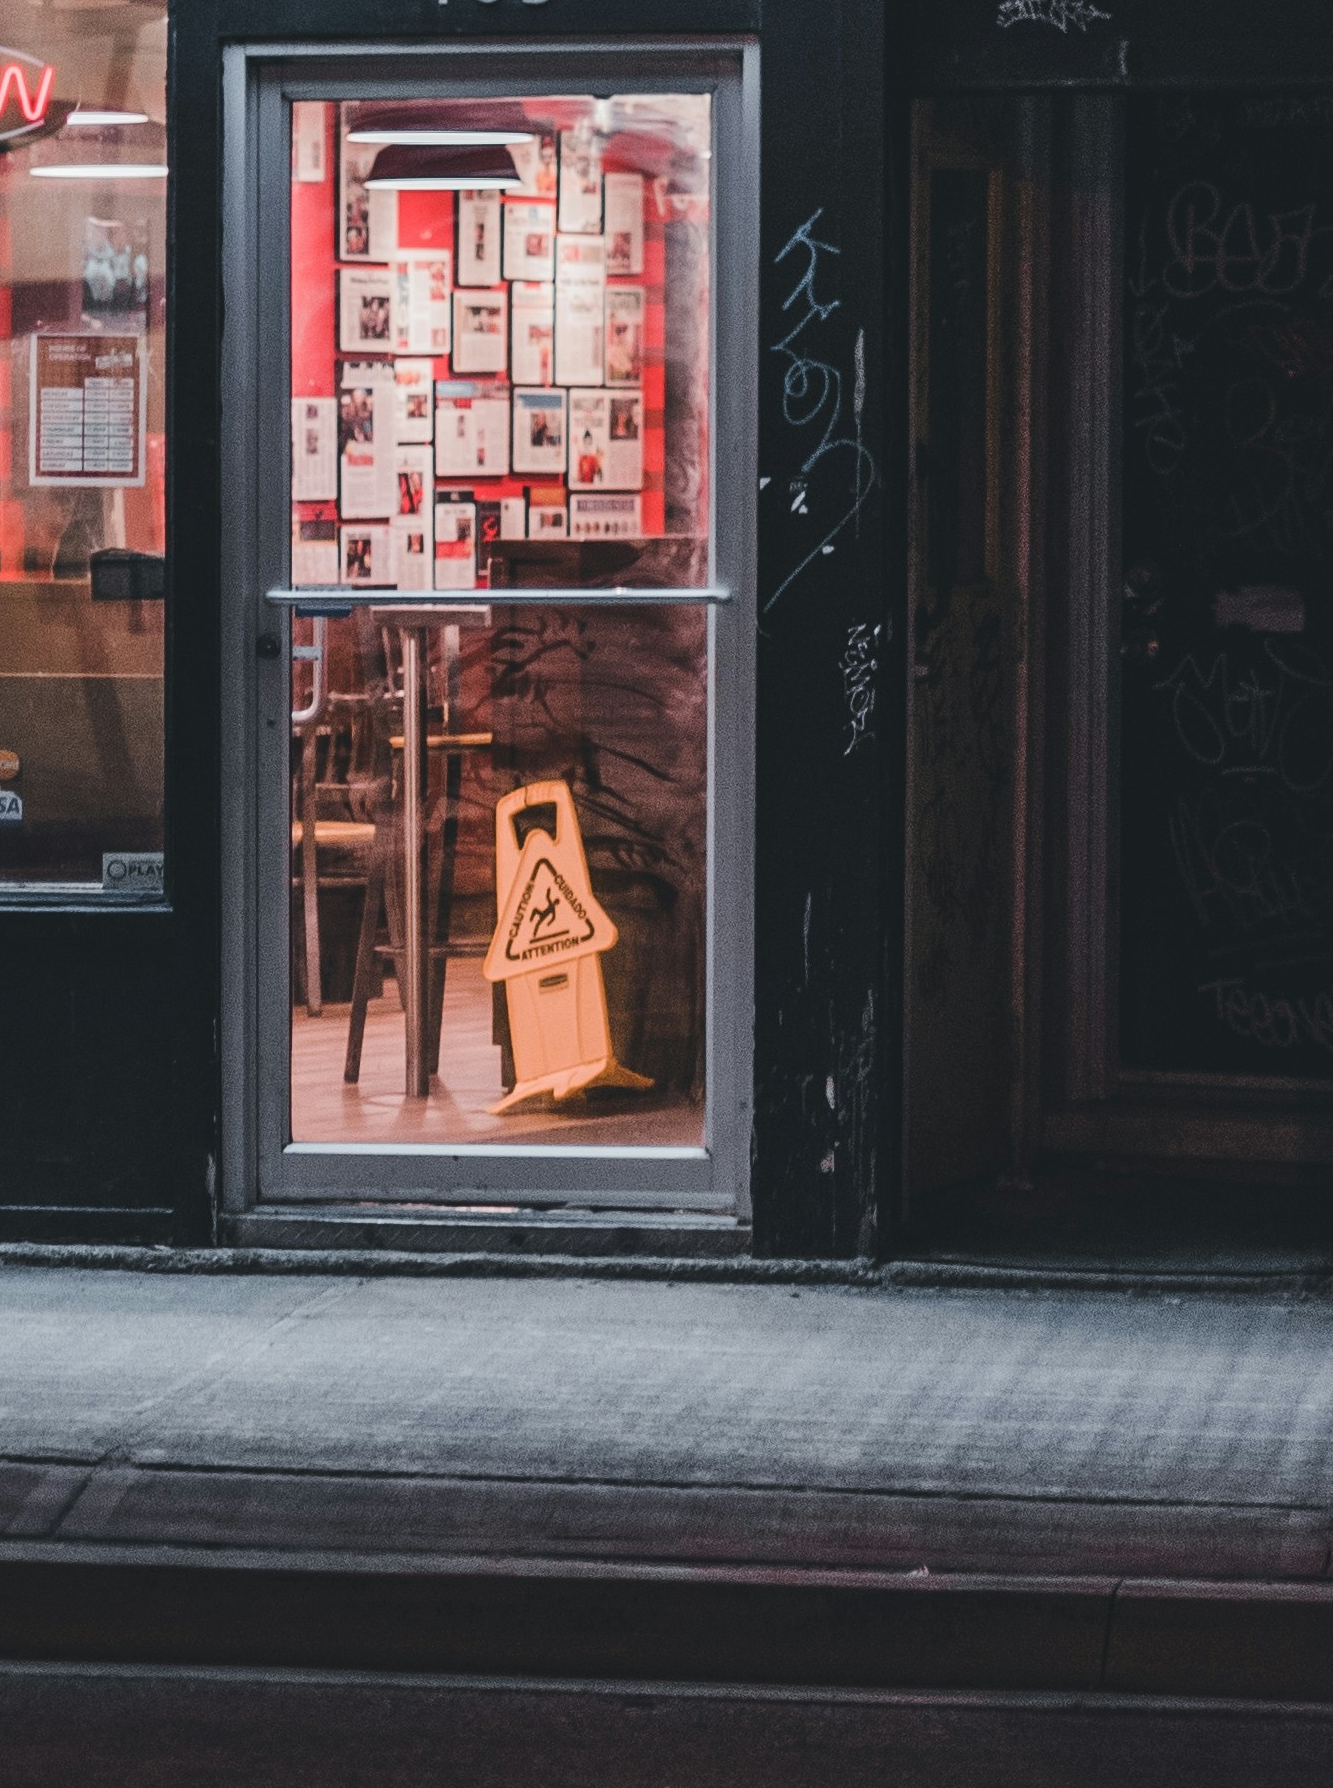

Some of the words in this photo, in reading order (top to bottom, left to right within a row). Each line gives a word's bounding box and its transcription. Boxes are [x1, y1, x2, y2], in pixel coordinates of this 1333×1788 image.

[510, 882, 535, 938] CAUTION
[555, 875, 587, 919] CUIDADO
[521, 936, 580, 960] ATTENTION
